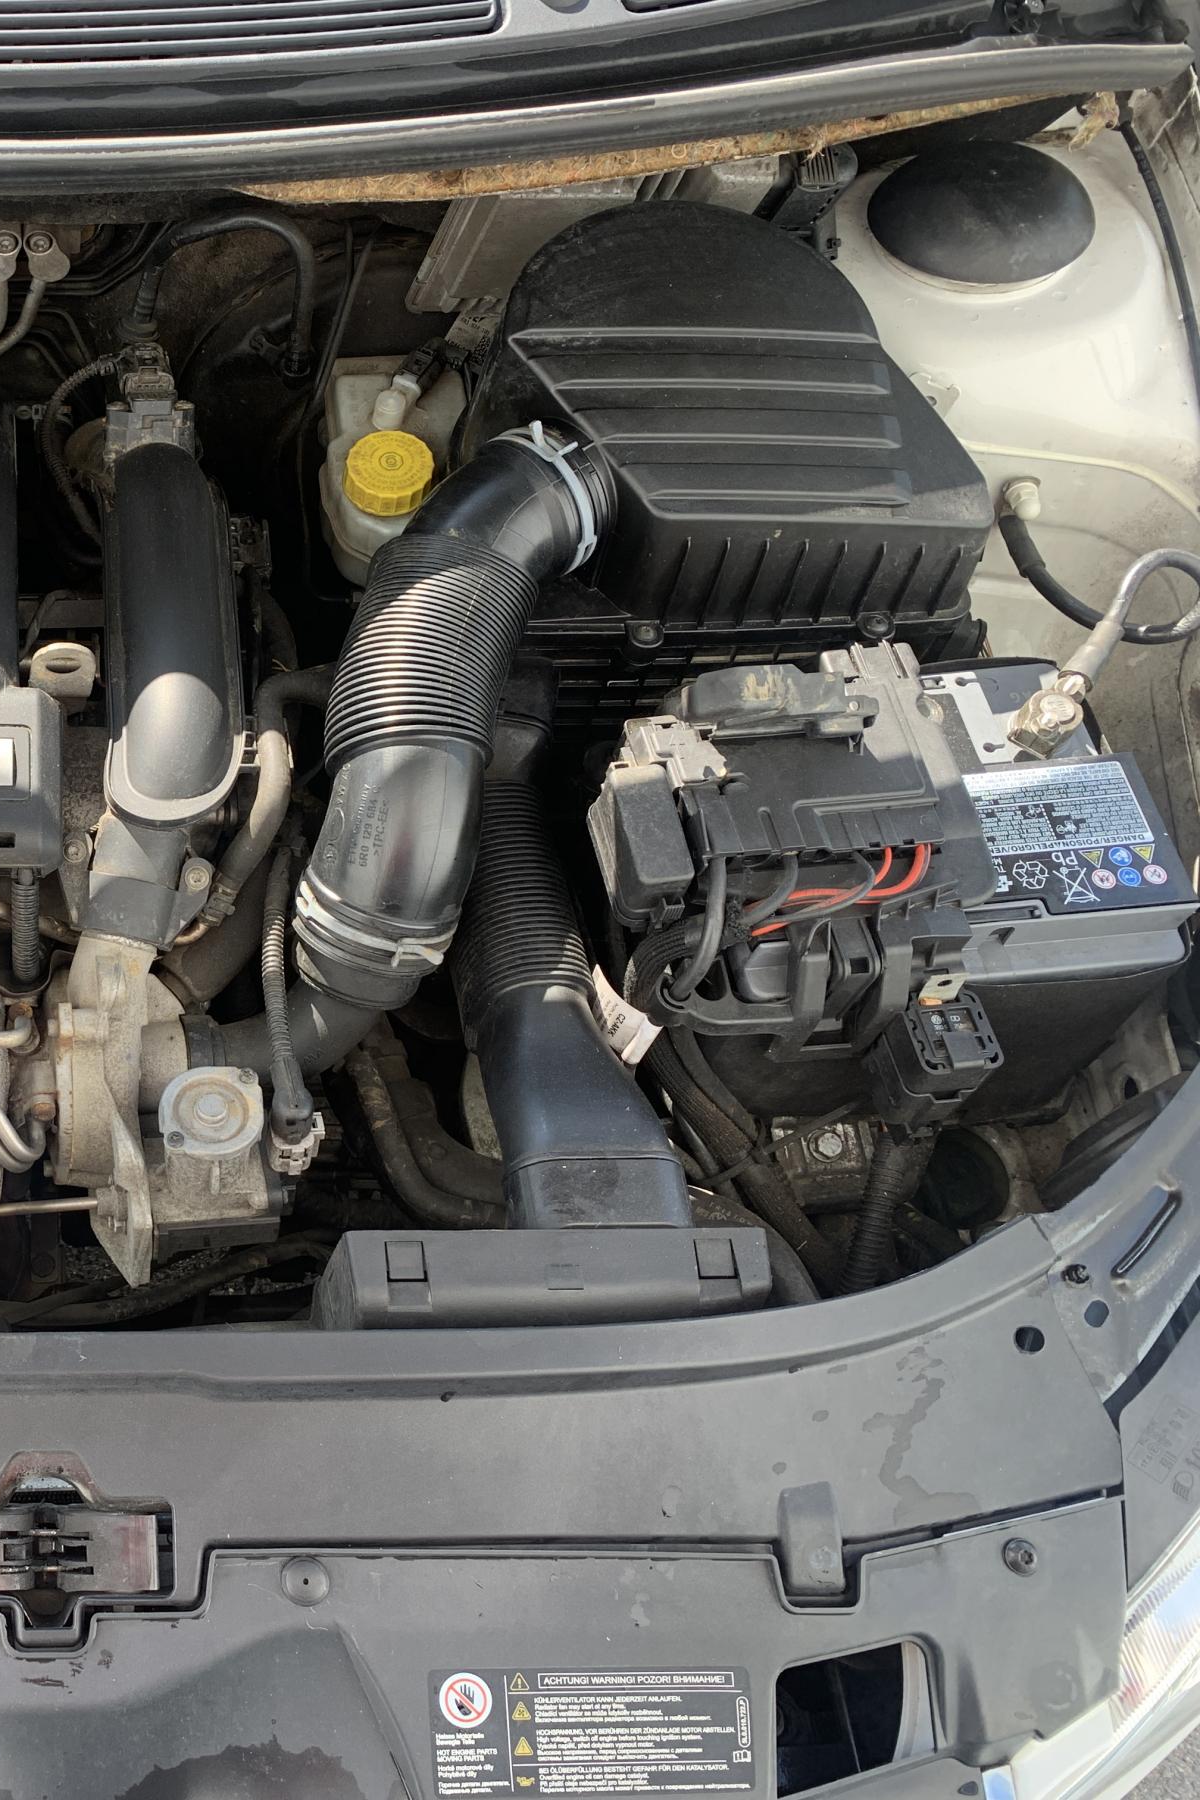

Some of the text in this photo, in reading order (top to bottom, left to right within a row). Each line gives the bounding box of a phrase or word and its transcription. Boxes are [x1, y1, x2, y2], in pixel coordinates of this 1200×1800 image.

[1052, 850, 1079, 866] Pb
[543, 1675, 725, 1685] ACHTUNG! WARNING! POZOR! ВНИМАНИЕ!
